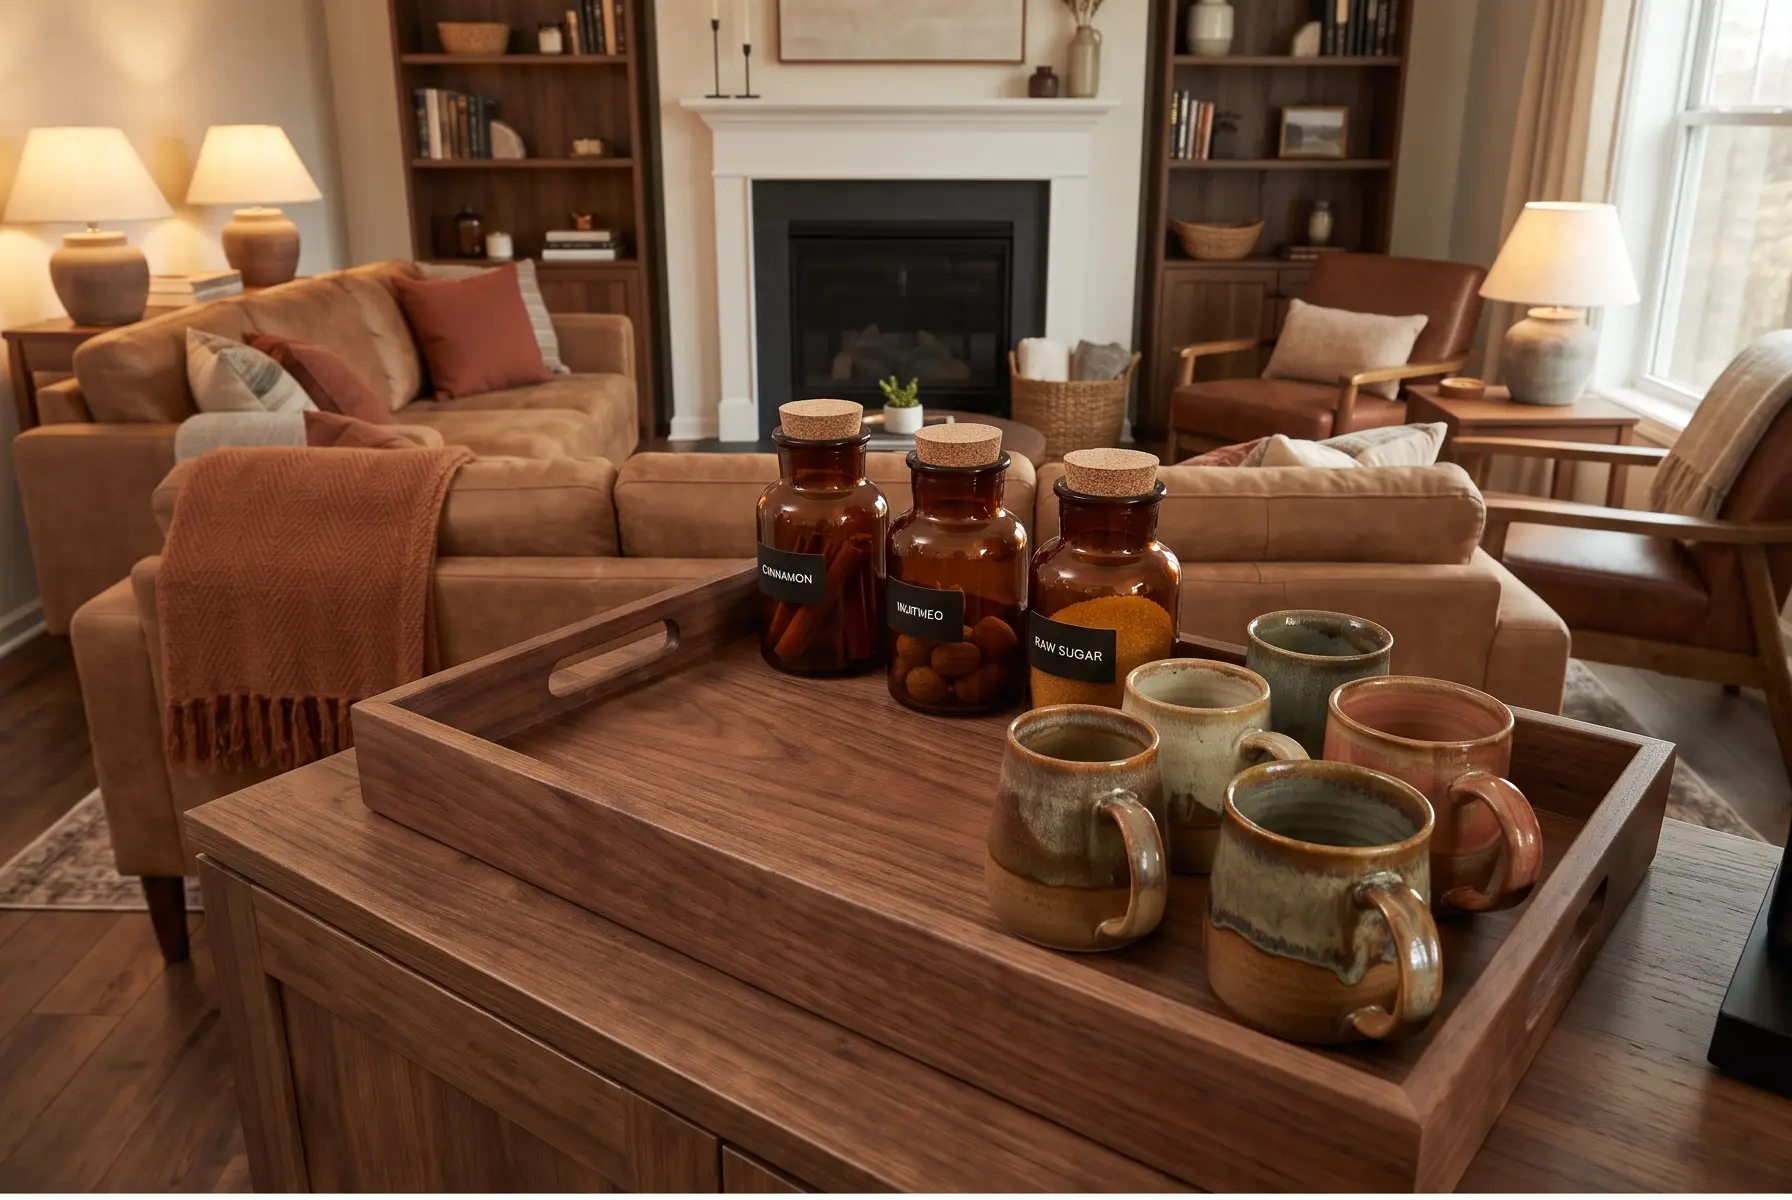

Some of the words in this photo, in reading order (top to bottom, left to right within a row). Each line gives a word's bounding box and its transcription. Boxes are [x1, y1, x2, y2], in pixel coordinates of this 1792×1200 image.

[762, 564, 813, 584] CINNAMON
[1034, 635, 1057, 653] RAW
[1058, 645, 1103, 662] SUGAR
